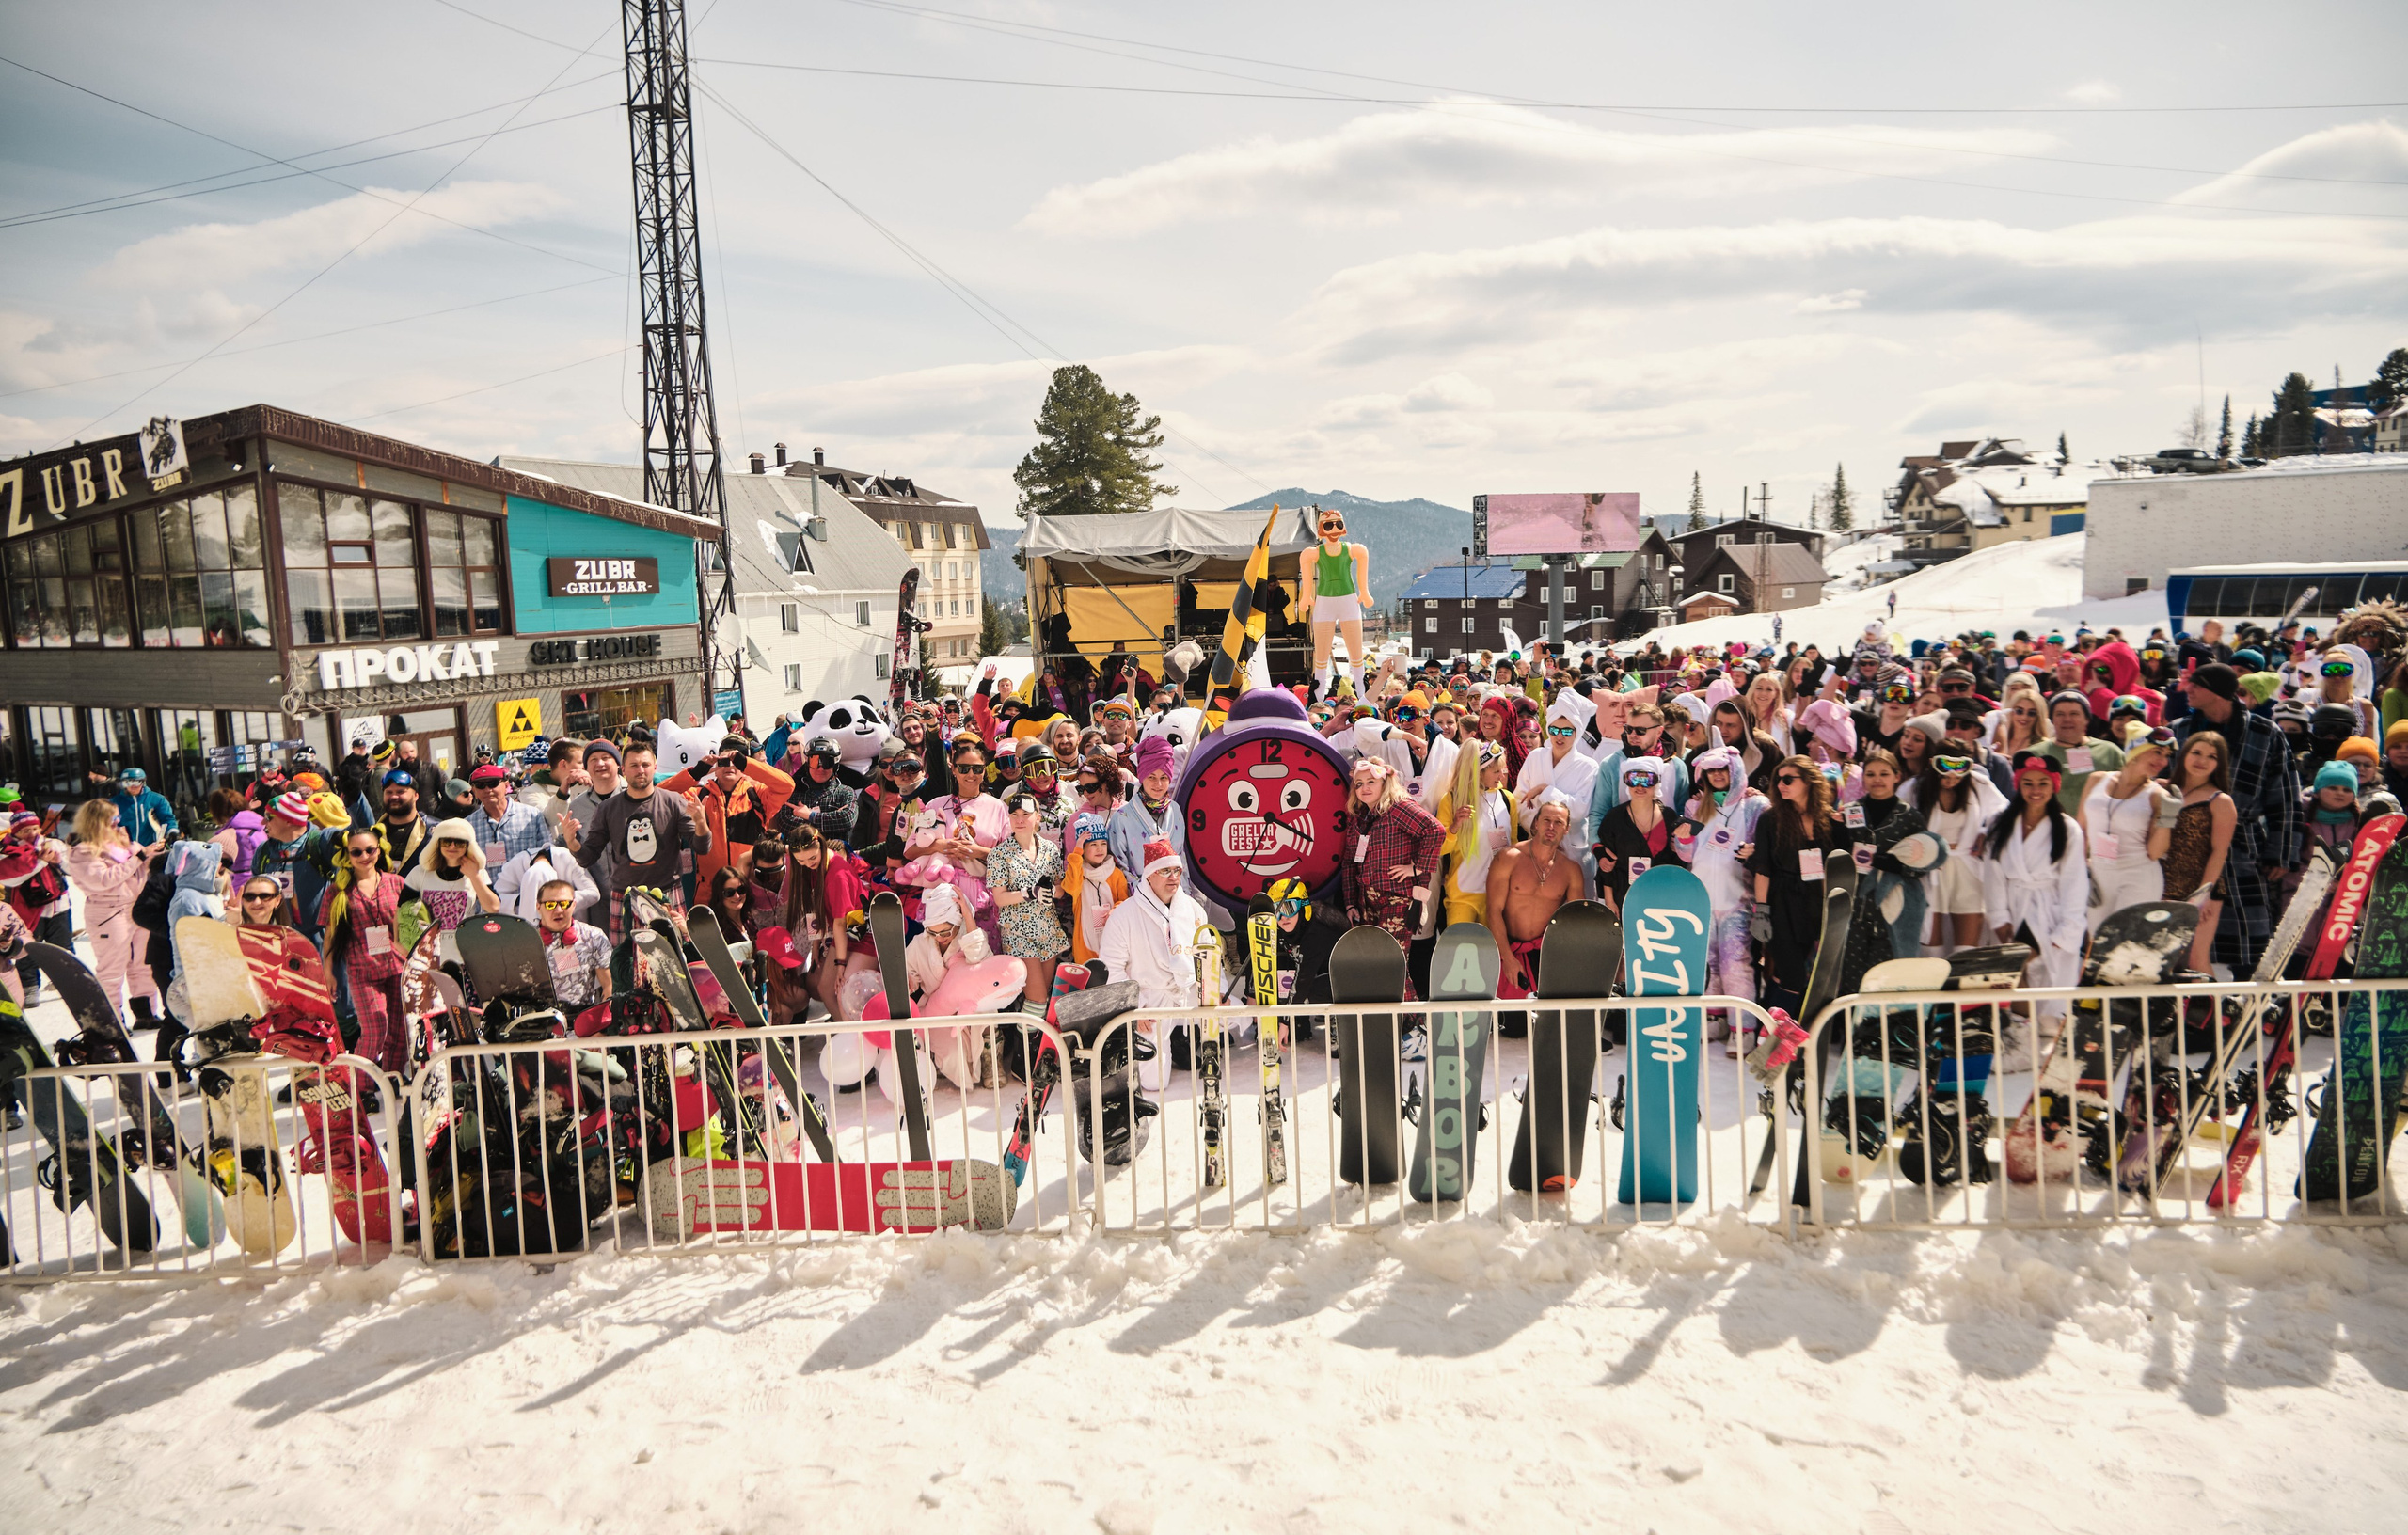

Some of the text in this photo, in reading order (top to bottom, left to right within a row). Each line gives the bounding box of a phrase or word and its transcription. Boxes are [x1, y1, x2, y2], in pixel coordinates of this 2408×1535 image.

[0, 448, 128, 538] ZUBR
[151, 470, 182, 492] ZUBR
[574, 560, 637, 580] ZUBR
[531, 634, 662, 666] SKI HOUSE
[318, 641, 499, 689] ПРОКАТ
[1260, 739, 1283, 763] 12
[1191, 809, 1206, 831] 9
[1231, 823, 1274, 837] GRELKA
[1332, 810, 1348, 833] 3
[1231, 836, 1260, 850] FEST
[2328, 837, 2382, 942] ATOMIC
[1254, 915, 1275, 1005] FISCHER
[1420, 943, 1486, 1195] ARBOR
